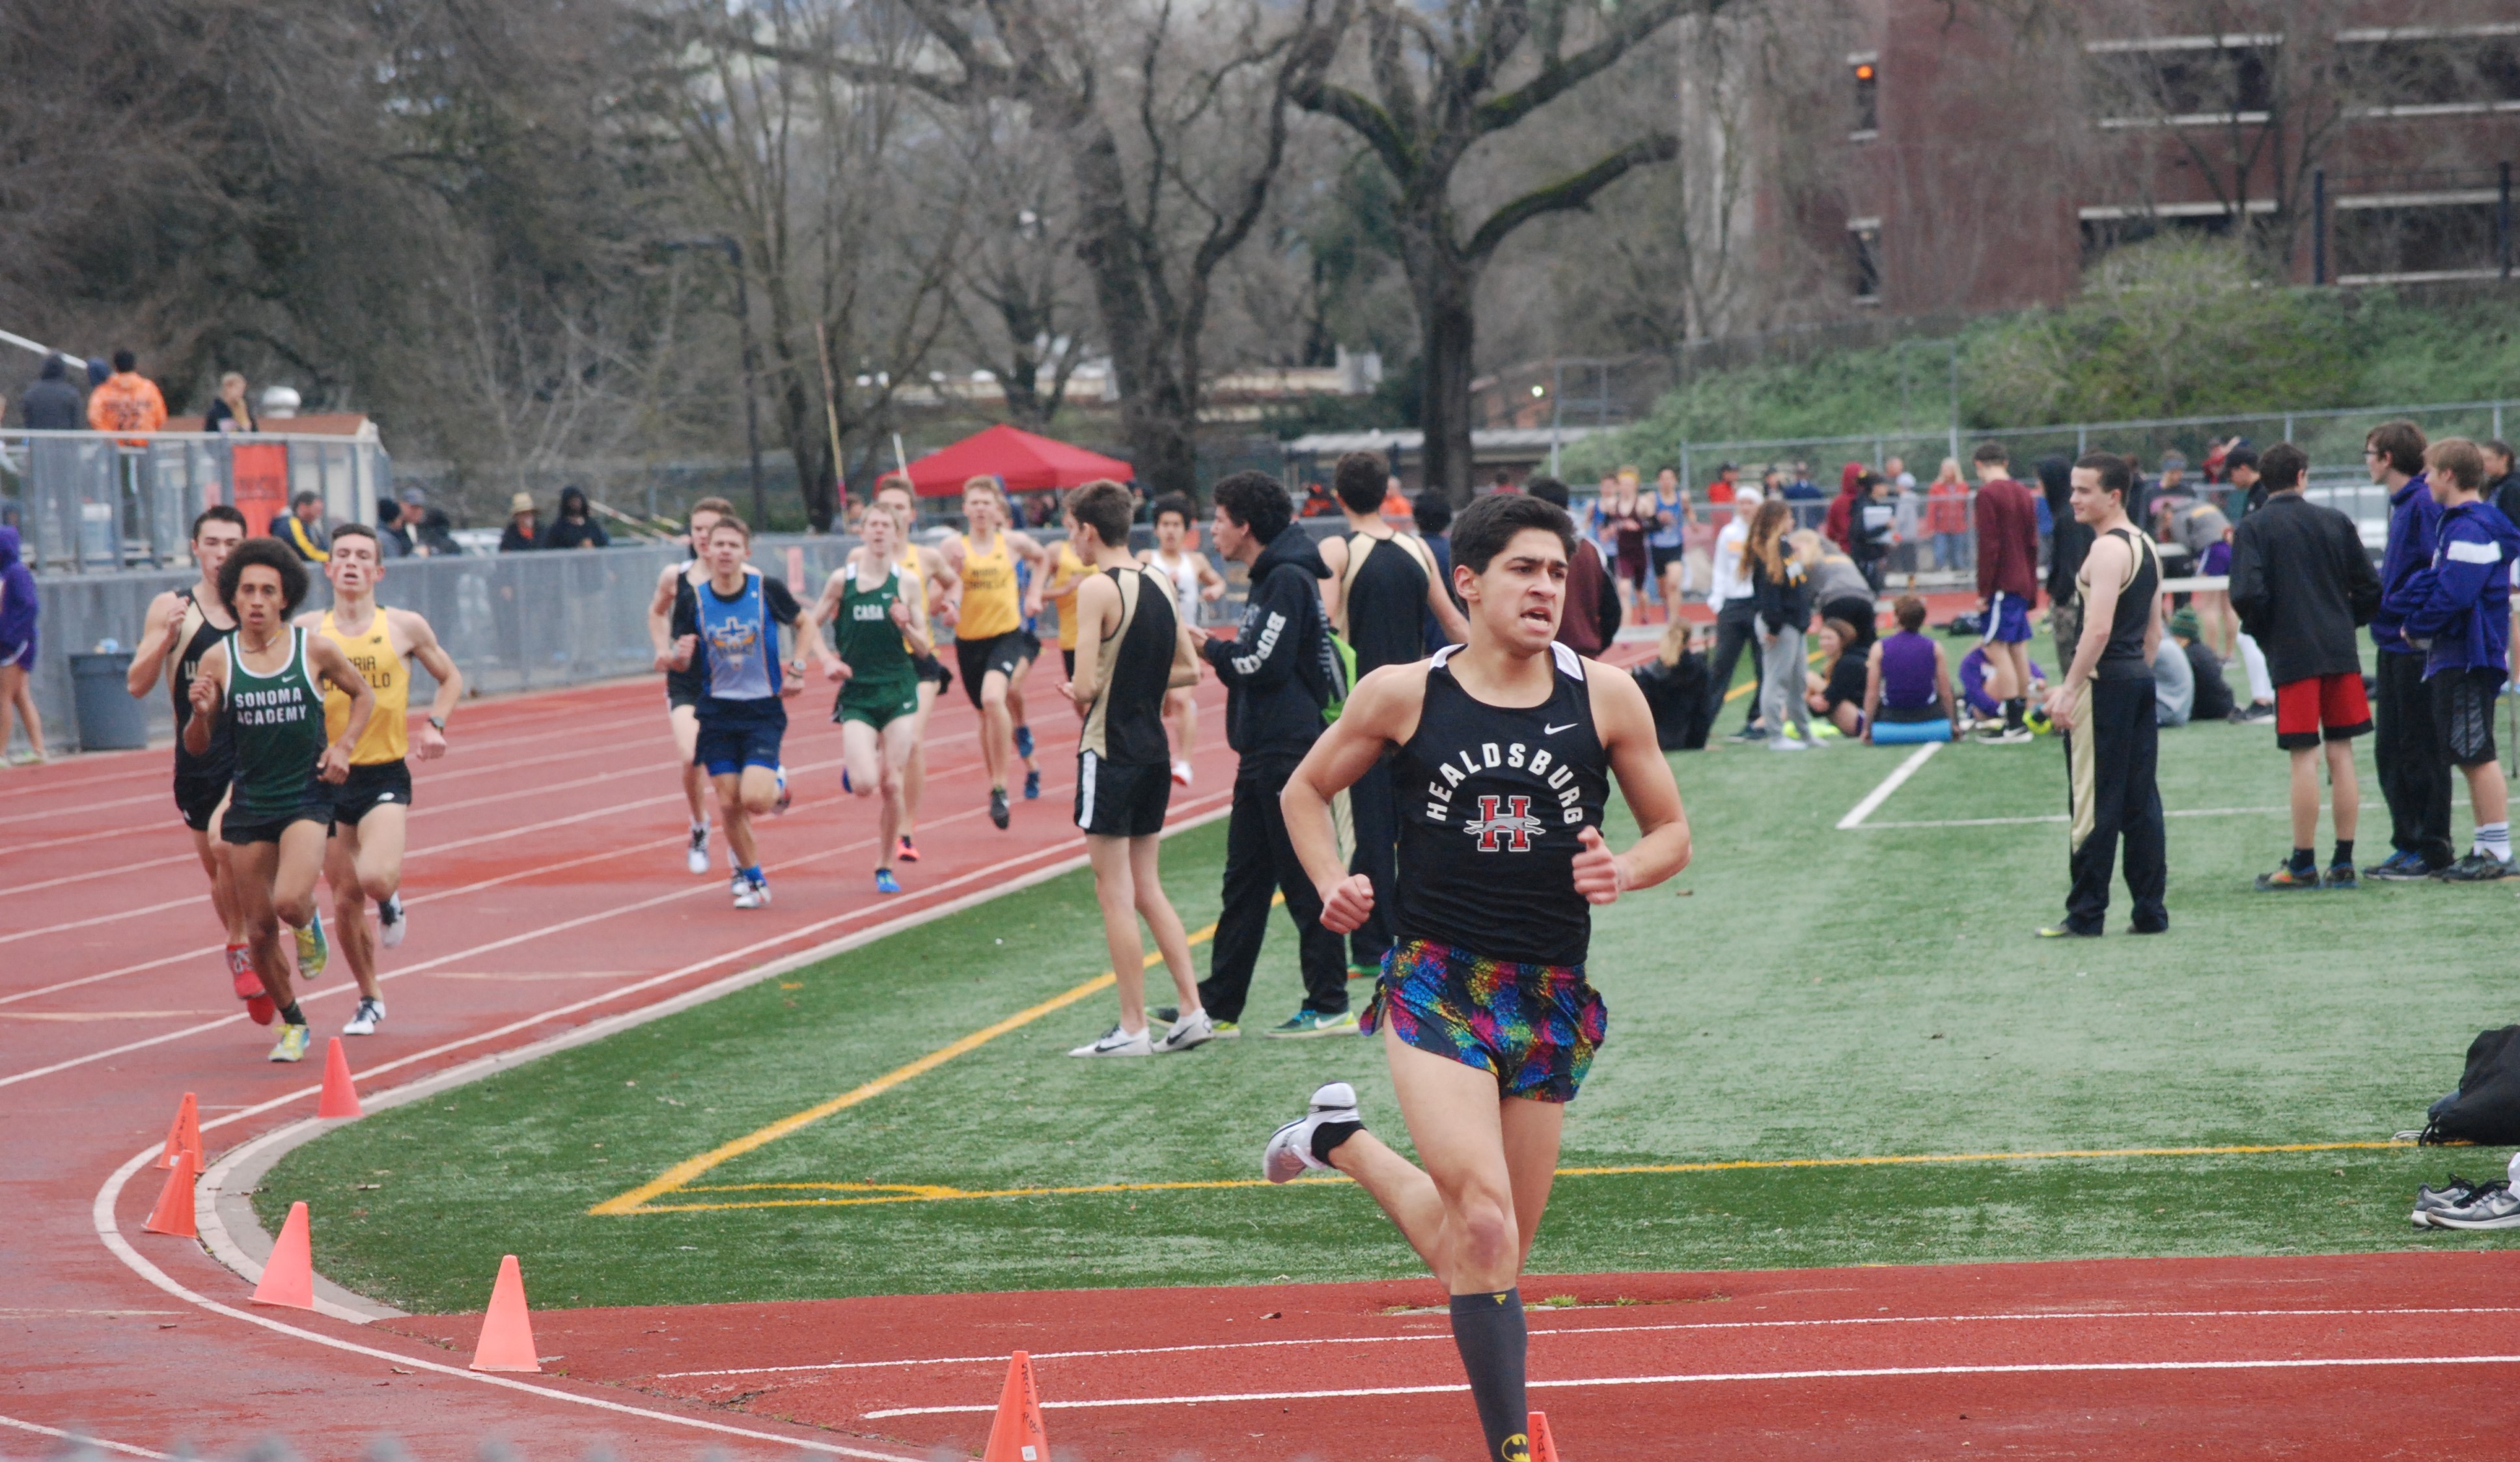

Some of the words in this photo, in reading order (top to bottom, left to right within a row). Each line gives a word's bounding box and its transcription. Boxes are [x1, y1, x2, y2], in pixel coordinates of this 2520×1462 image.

[234, 687, 303, 708] SONOMA
[237, 704, 307, 725] ACADEMY
[1426, 743, 1583, 824] HEALDSBURG
